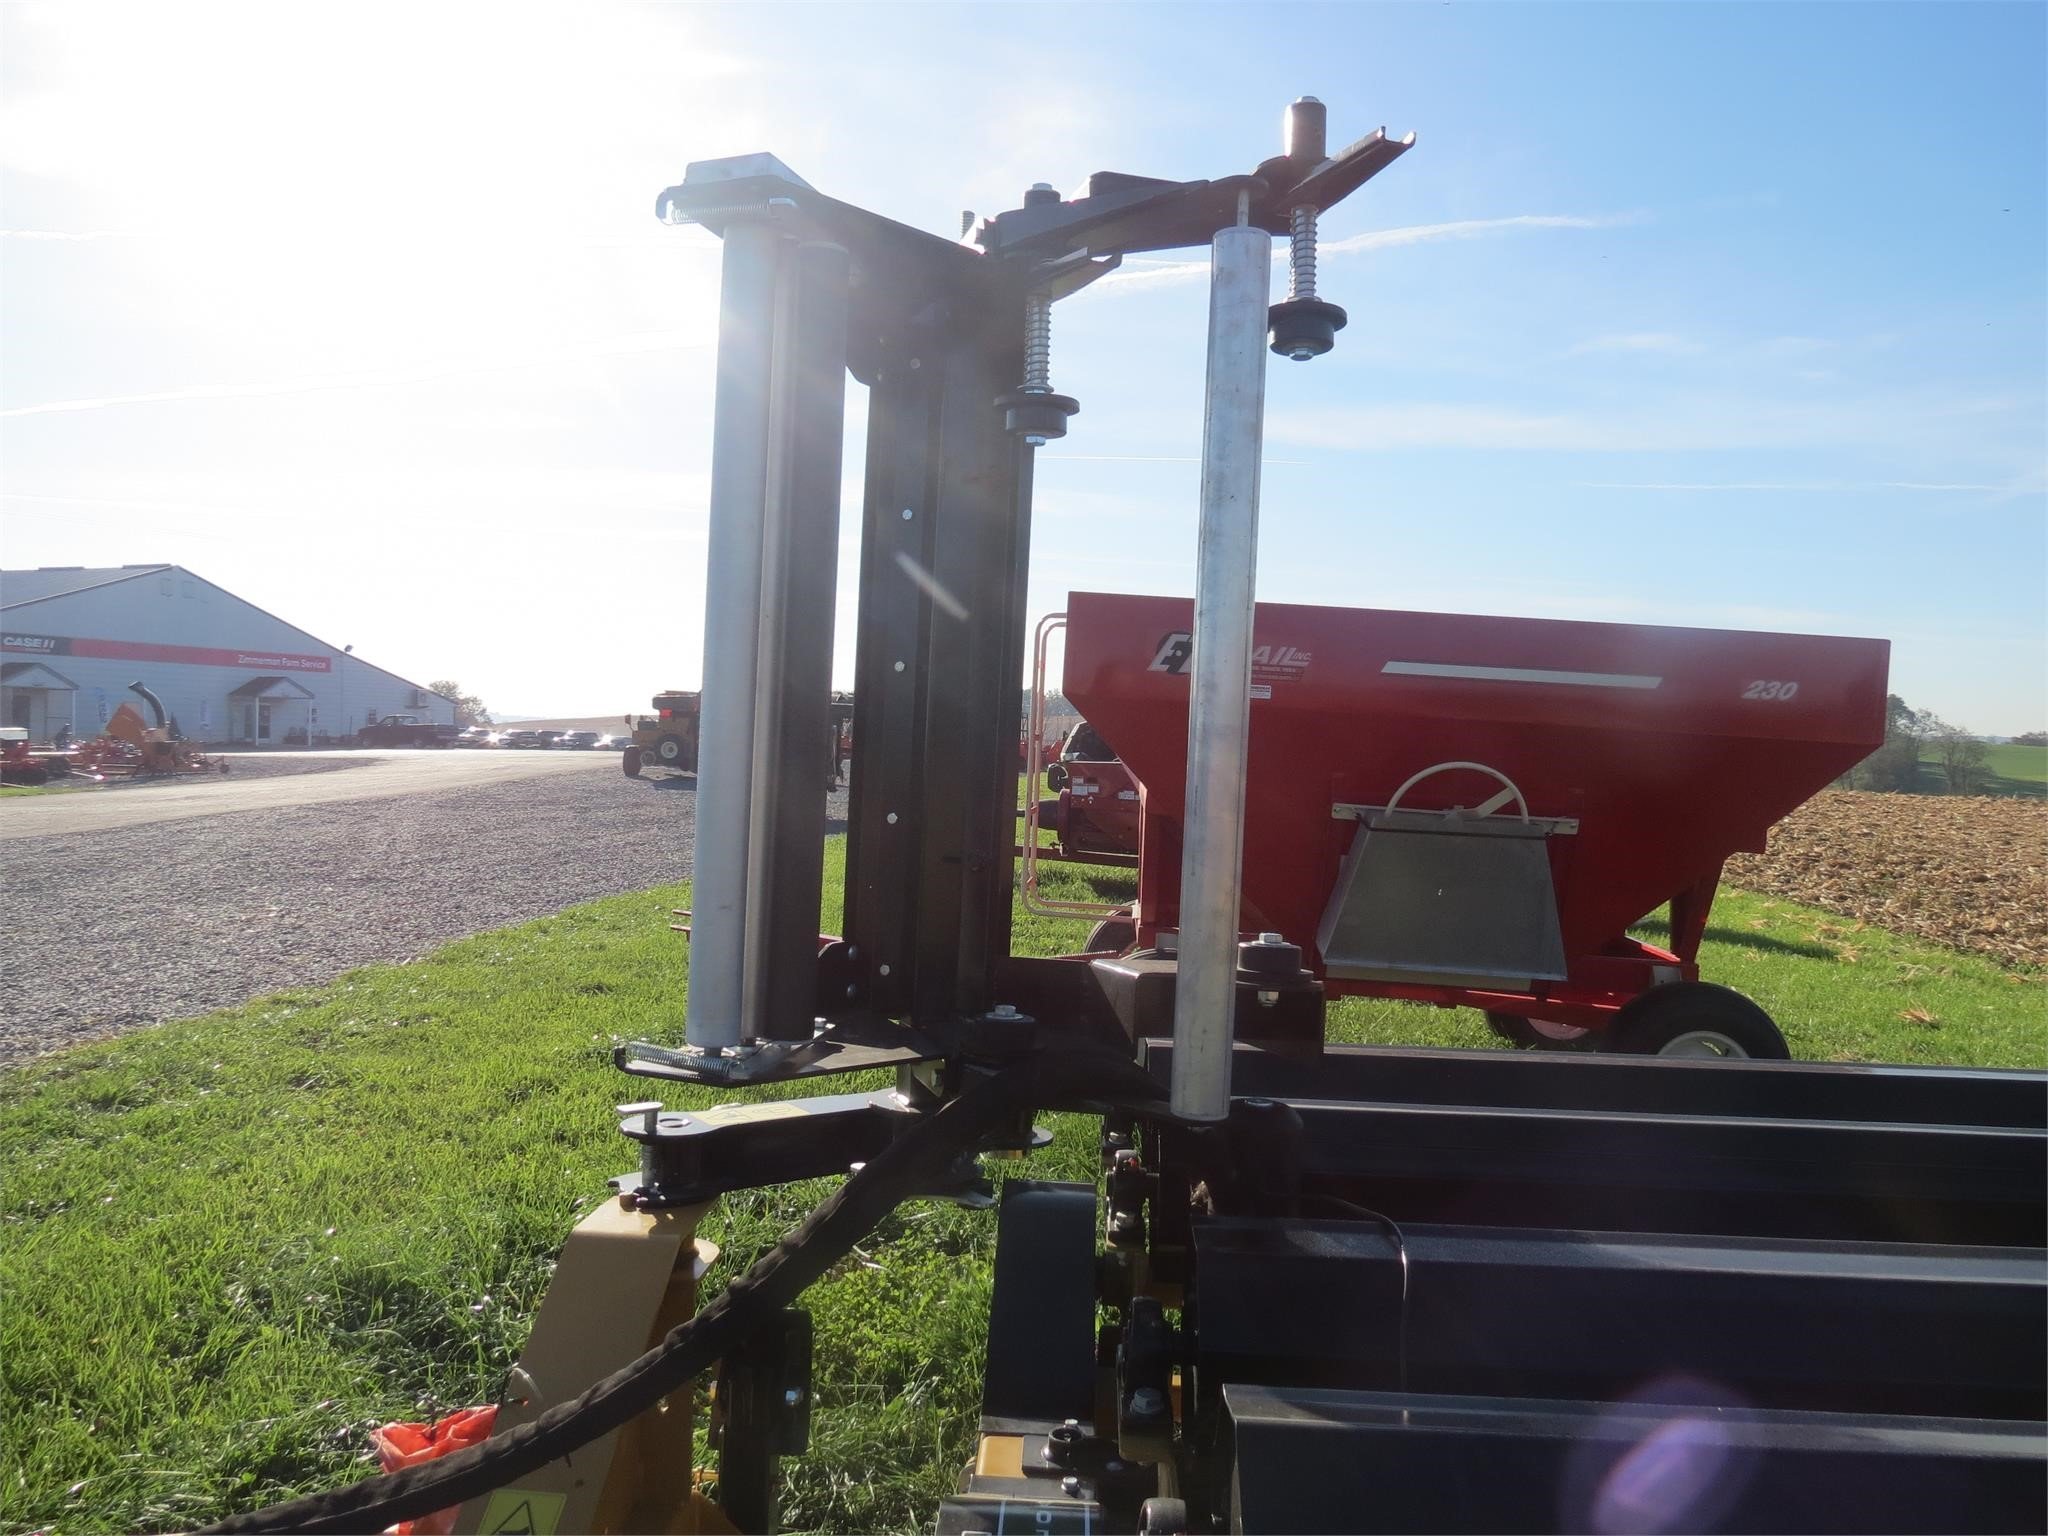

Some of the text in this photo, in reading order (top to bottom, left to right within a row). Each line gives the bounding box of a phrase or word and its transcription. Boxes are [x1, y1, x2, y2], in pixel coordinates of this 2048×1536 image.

[3, 636, 42, 648] CASE
[282, 657, 300, 667] Farm
[301, 659, 326, 669] Service
[1742, 680, 1798, 700] 230
